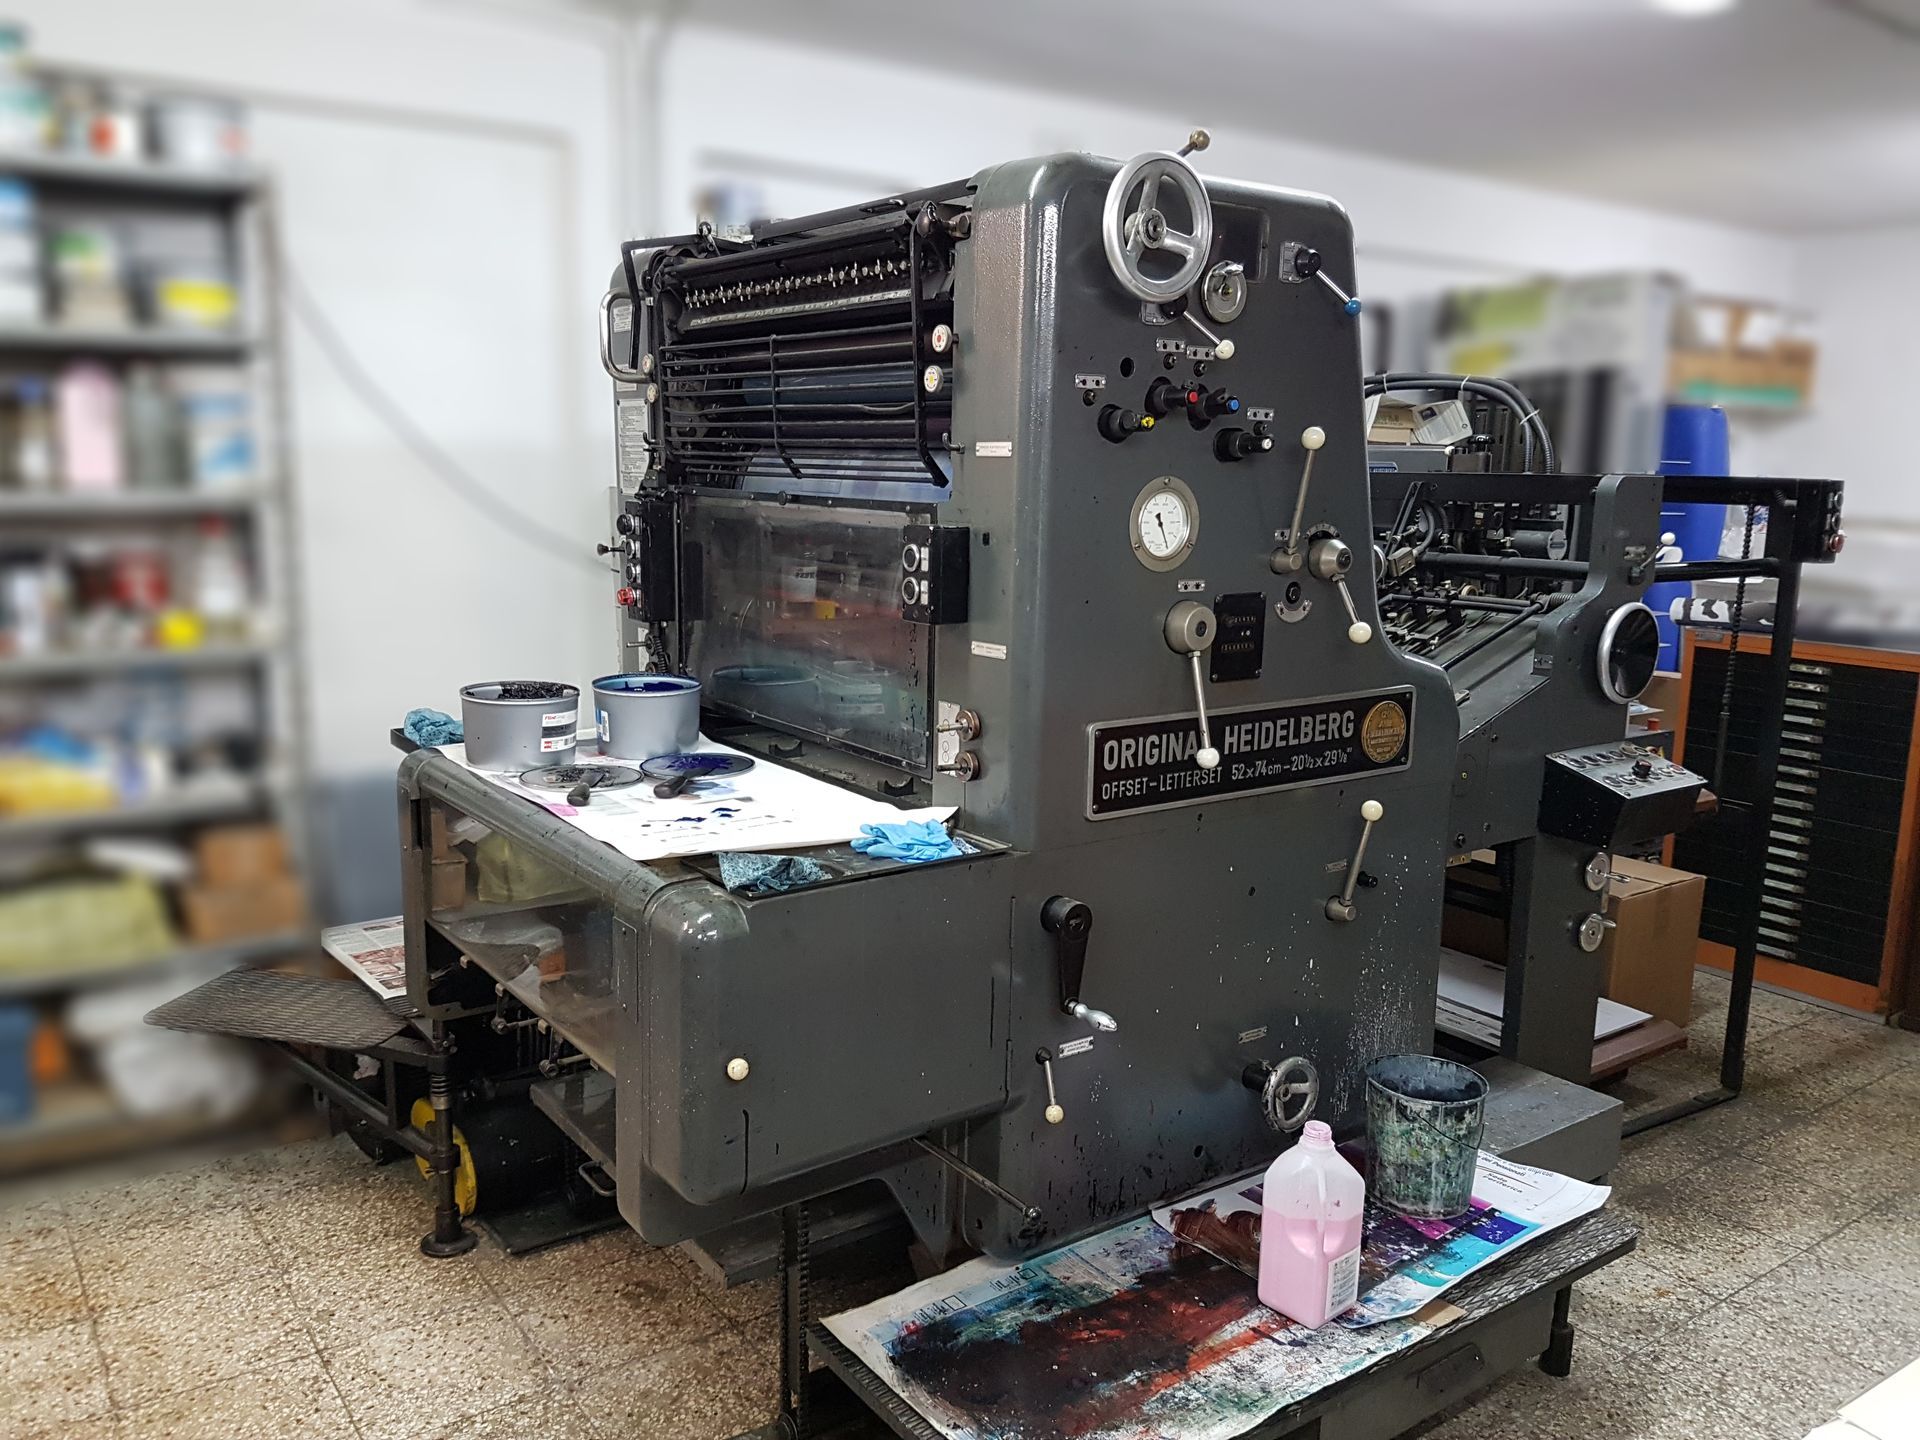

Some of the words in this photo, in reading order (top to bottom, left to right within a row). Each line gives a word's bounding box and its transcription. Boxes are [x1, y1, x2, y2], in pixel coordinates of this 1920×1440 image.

[1103, 730, 1200, 771] ORIGINA
[1224, 710, 1355, 755] HEIDELBERG
[1102, 766, 1222, 800] OFFSET-LETTERSET
